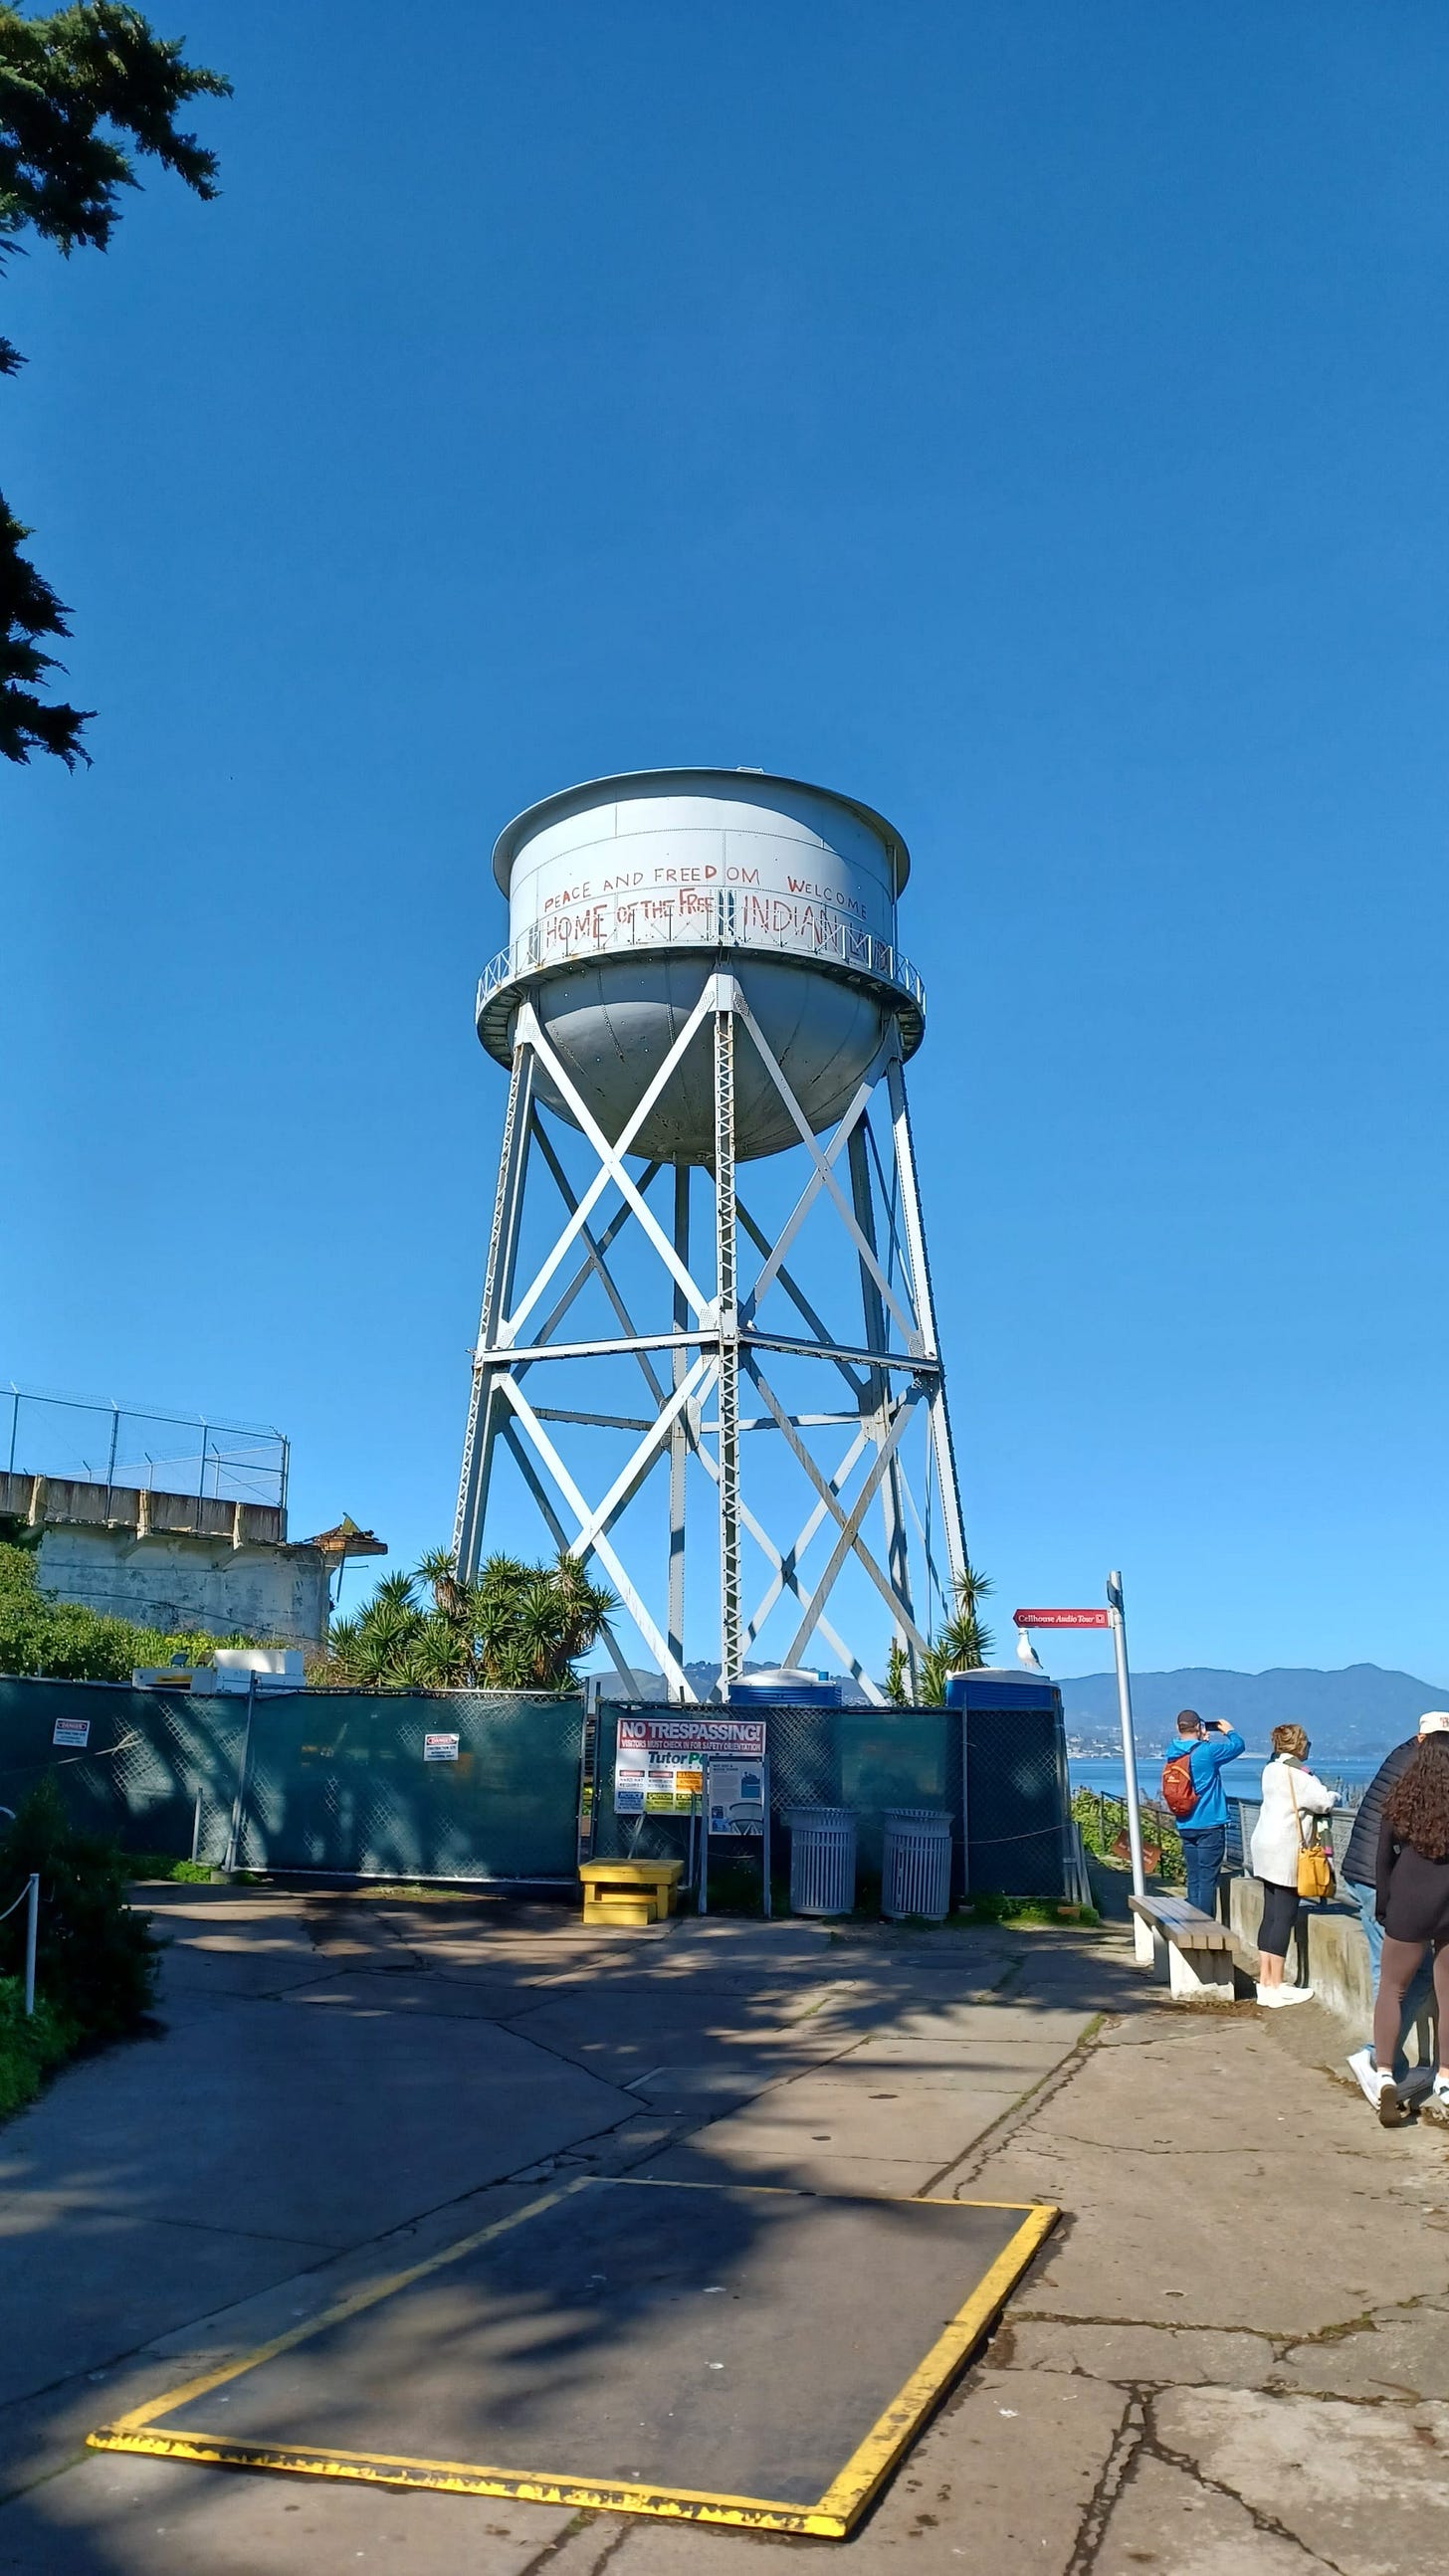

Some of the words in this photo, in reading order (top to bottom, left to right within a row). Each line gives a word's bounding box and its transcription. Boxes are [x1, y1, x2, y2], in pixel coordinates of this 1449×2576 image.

[543, 882, 592, 912] PEACE
[603, 872, 644, 892] AND
[787, 876, 868, 919] WELCOME
[546, 904, 608, 948] HOME
[617, 902, 639, 924] OF
[640, 899, 676, 920] THE
[743, 895, 838, 952] INDIAN
[1018, 1614, 1055, 1623] Cellhouse
[1055, 1614, 1077, 1623] Audio
[622, 1721, 646, 1737] NO
[648, 1722, 761, 1741] TRESPASSING!
[621, 1739, 647, 1748] VISITORS
[691, 1741, 702, 1750] FOR
[724, 1742, 761, 1751] ORIENTATION
